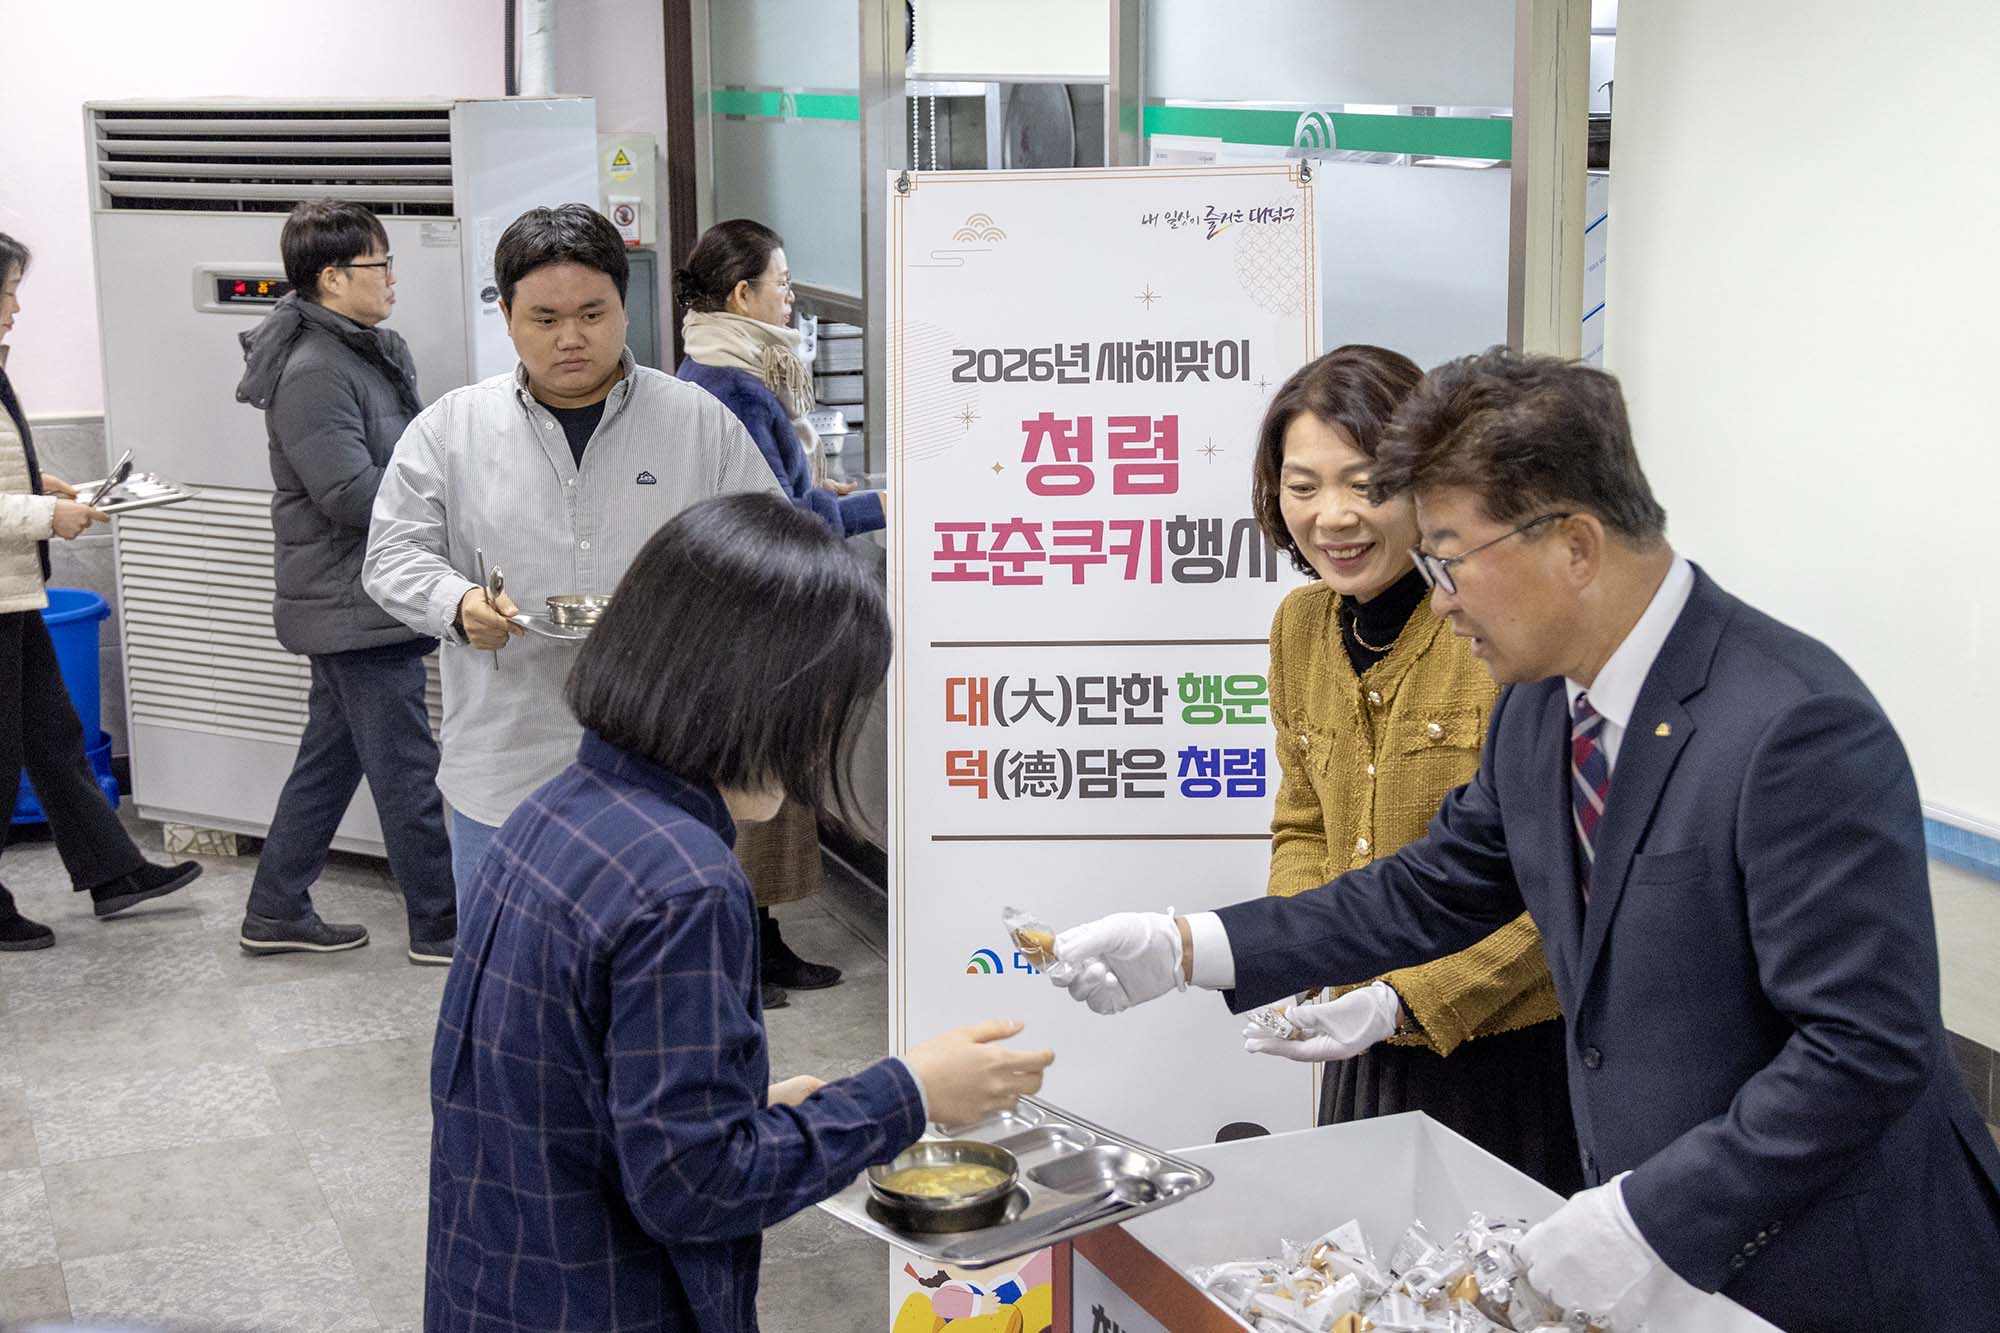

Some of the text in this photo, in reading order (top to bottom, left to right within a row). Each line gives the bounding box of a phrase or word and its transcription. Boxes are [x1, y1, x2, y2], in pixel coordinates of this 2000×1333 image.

[1142, 206, 1294, 240] 내 일상이 즐거운 대덕구
[953, 340, 1249, 384] 2026년 새해맞이
[1021, 412, 1178, 496] 청렴
[946, 672, 1268, 727] 대(大)단한 행운
[946, 746, 1266, 800] 덕(德)담은 청렴
